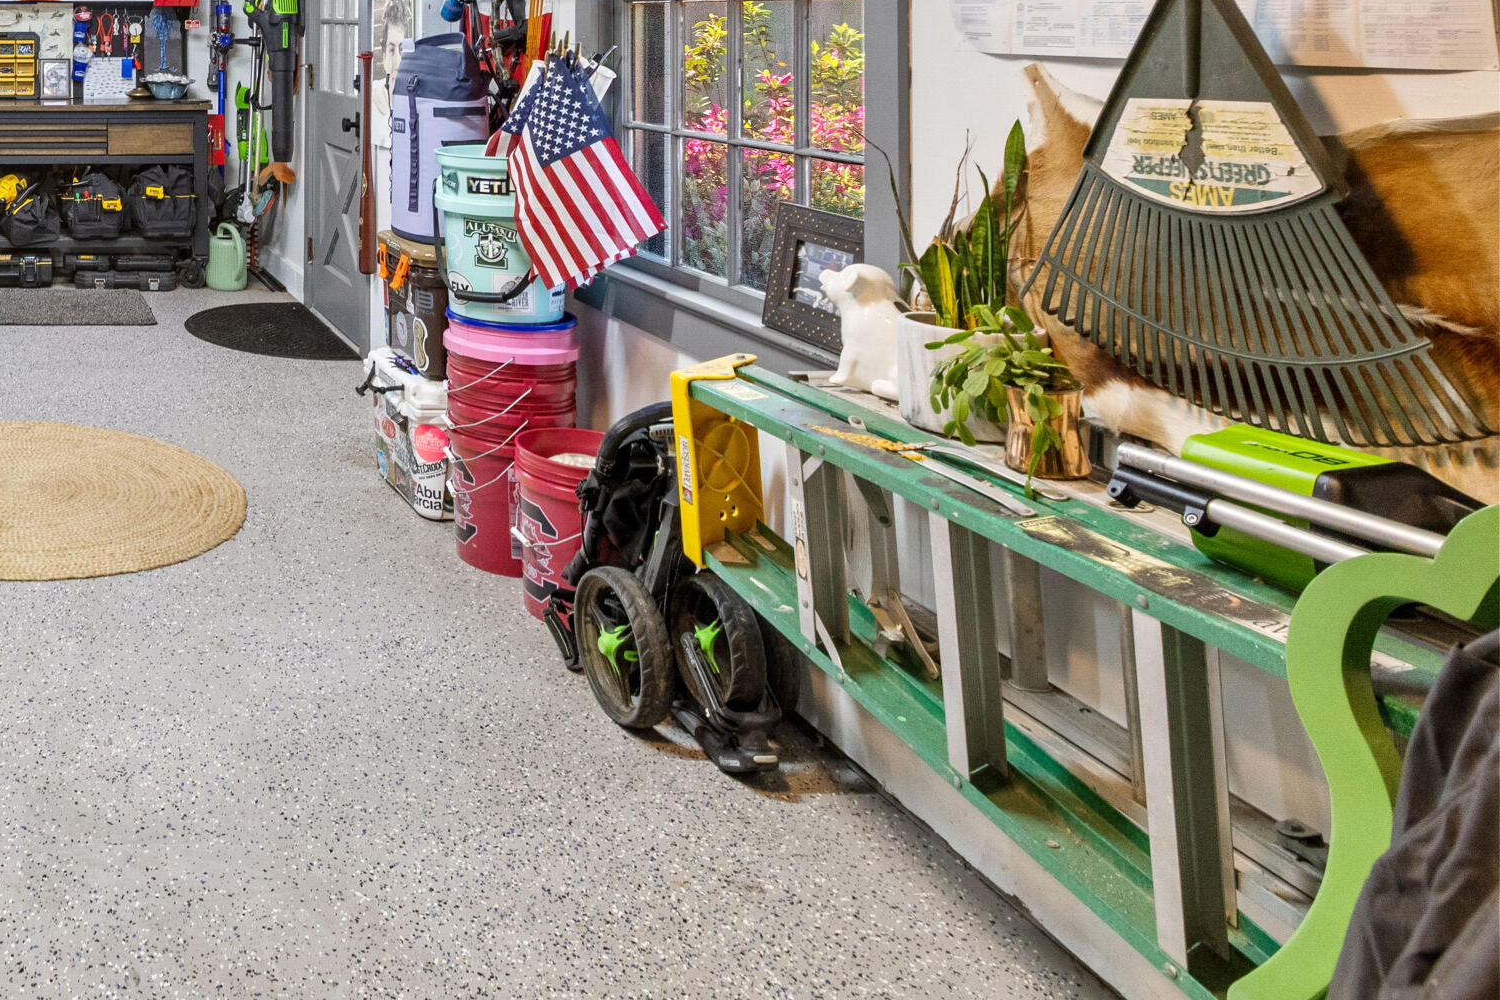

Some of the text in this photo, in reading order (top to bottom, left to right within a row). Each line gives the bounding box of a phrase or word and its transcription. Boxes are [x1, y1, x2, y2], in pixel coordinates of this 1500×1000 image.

[1151, 112, 1177, 121] AMES
[1133, 154, 1271, 187] GREENSEEPER
[469, 180, 507, 193] YETI
[1168, 181, 1236, 207] AMES
[466, 221, 514, 238] ALUMNI
[682, 439, 693, 489] Davidson
[417, 483, 442, 500] Abu
[414, 494, 442, 511] arcia
